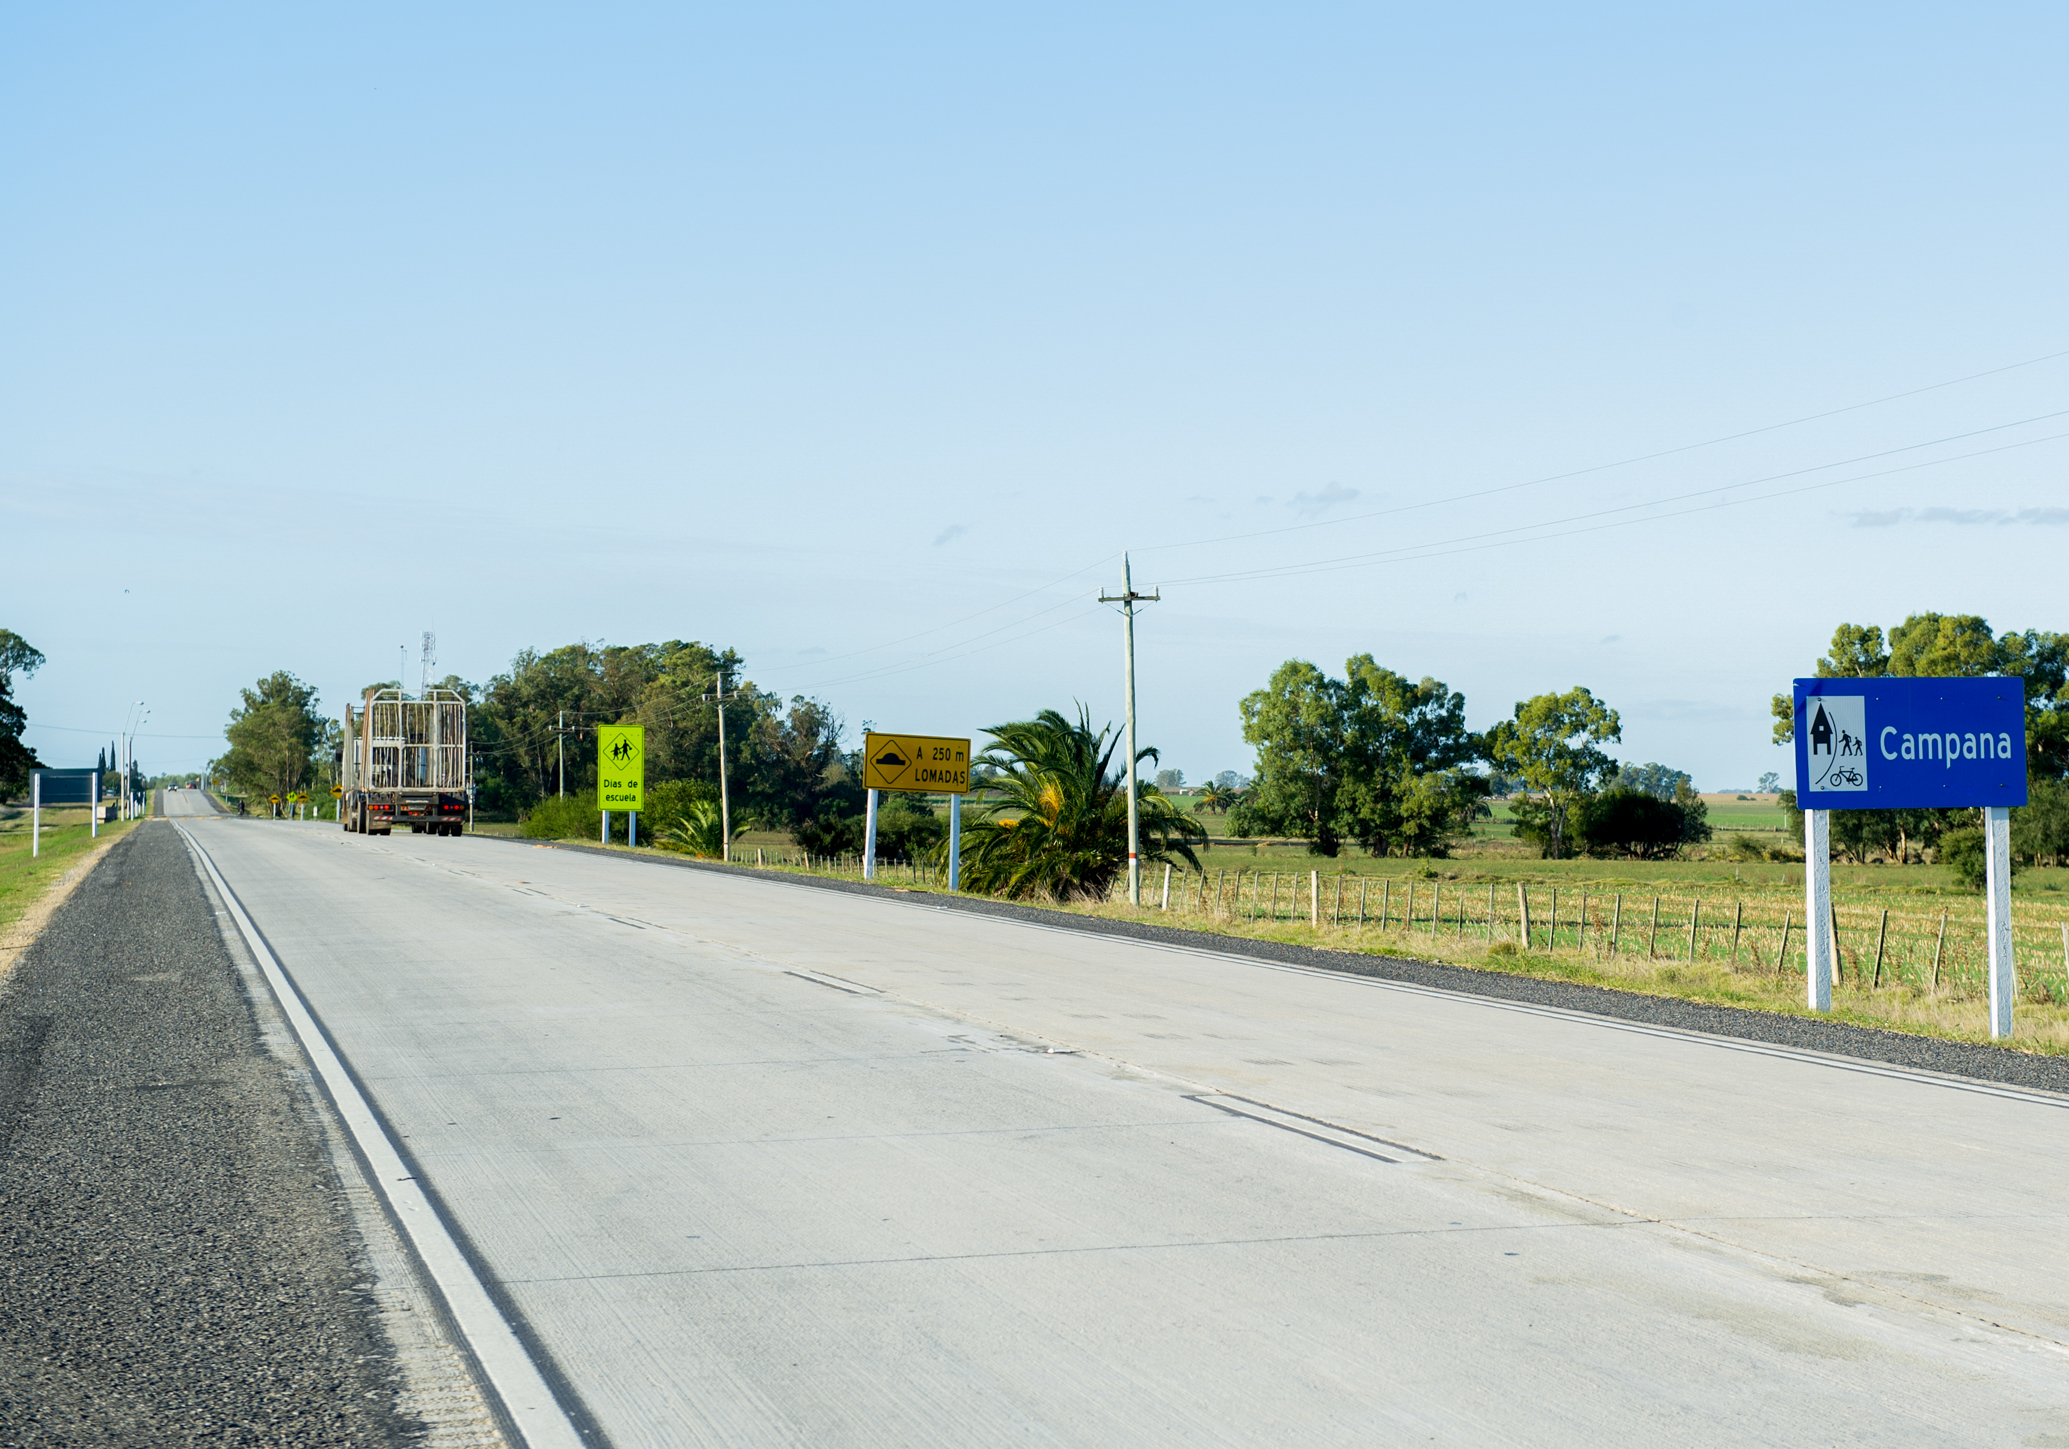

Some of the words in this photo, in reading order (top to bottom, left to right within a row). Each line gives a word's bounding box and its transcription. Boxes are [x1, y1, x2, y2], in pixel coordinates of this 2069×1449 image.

[916, 746, 923, 760] A
[932, 747, 951, 761] 250
[955, 751, 964, 762] m
[1880, 725, 2012, 770] Campana
[627, 779, 638, 788] de
[915, 768, 966, 785] LOMADAS
[605, 793, 636, 802] escuela
